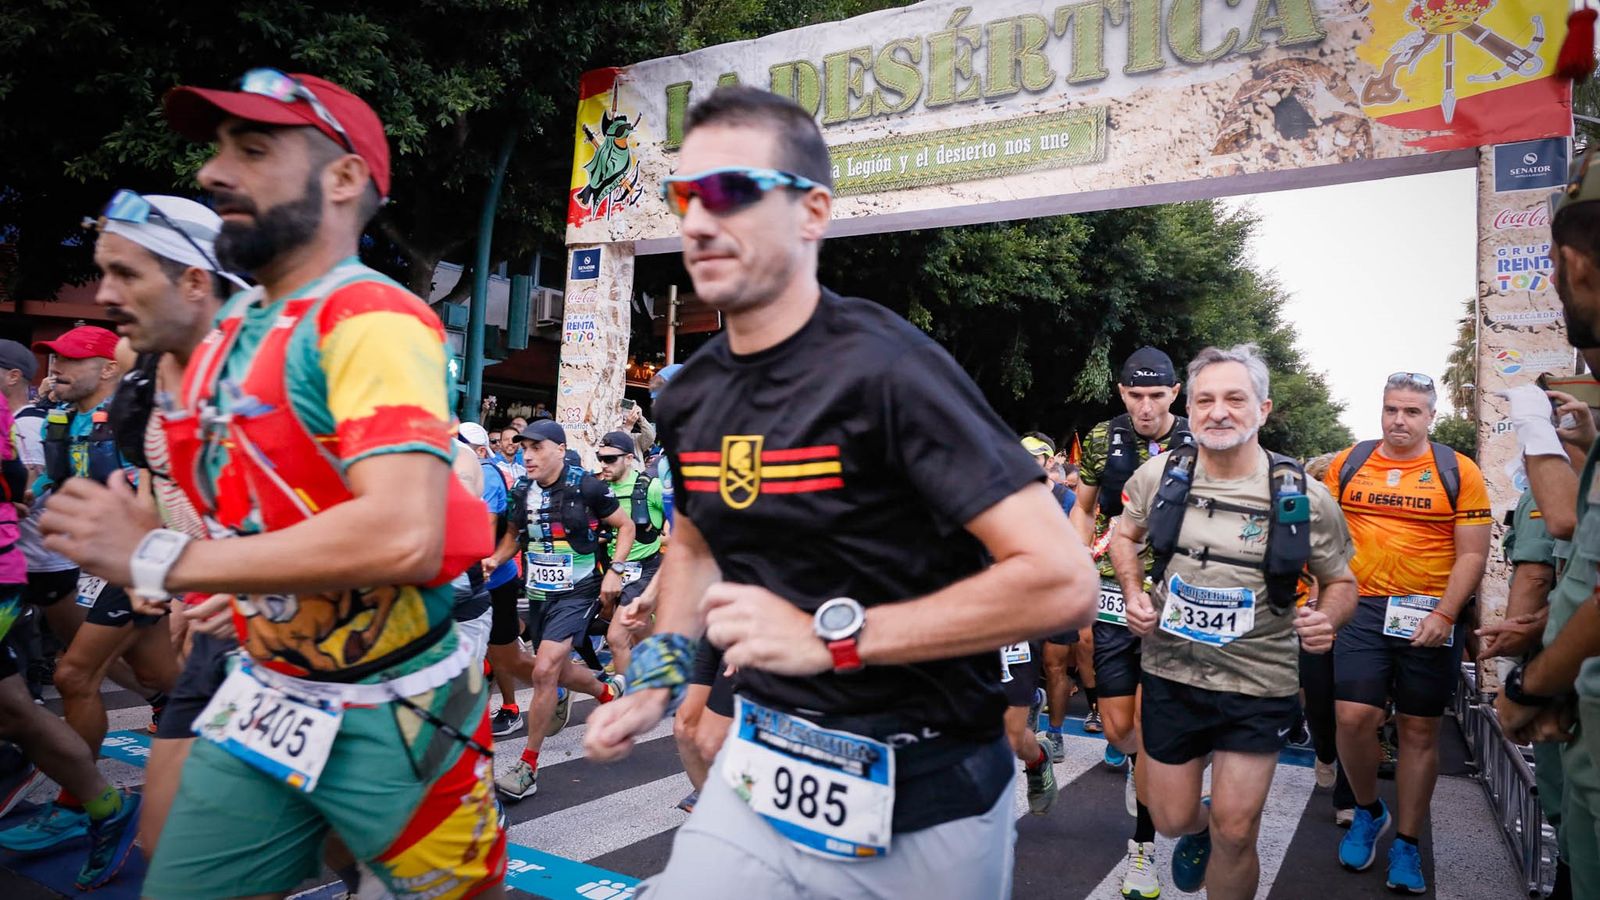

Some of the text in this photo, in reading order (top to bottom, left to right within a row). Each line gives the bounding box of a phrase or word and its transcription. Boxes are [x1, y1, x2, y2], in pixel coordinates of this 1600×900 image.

[769, 0, 1327, 126] DESÉRTICA
[847, 153, 892, 180] Legión
[899, 154, 910, 171] y
[916, 146, 929, 169] el
[936, 140, 997, 165] desierto
[1004, 138, 1031, 157] nos
[1040, 130, 1070, 150] une
[1509, 165, 1552, 176] SENATOR
[1497, 244, 1550, 257] GRUP
[1497, 255, 1554, 273] RENT
[566, 321, 595, 331] RENTA
[1350, 490, 1363, 502] LA
[536, 568, 565, 582] 1933
[1183, 606, 1238, 632] 3341
[239, 692, 315, 757] 3405
[773, 766, 849, 827] 985
